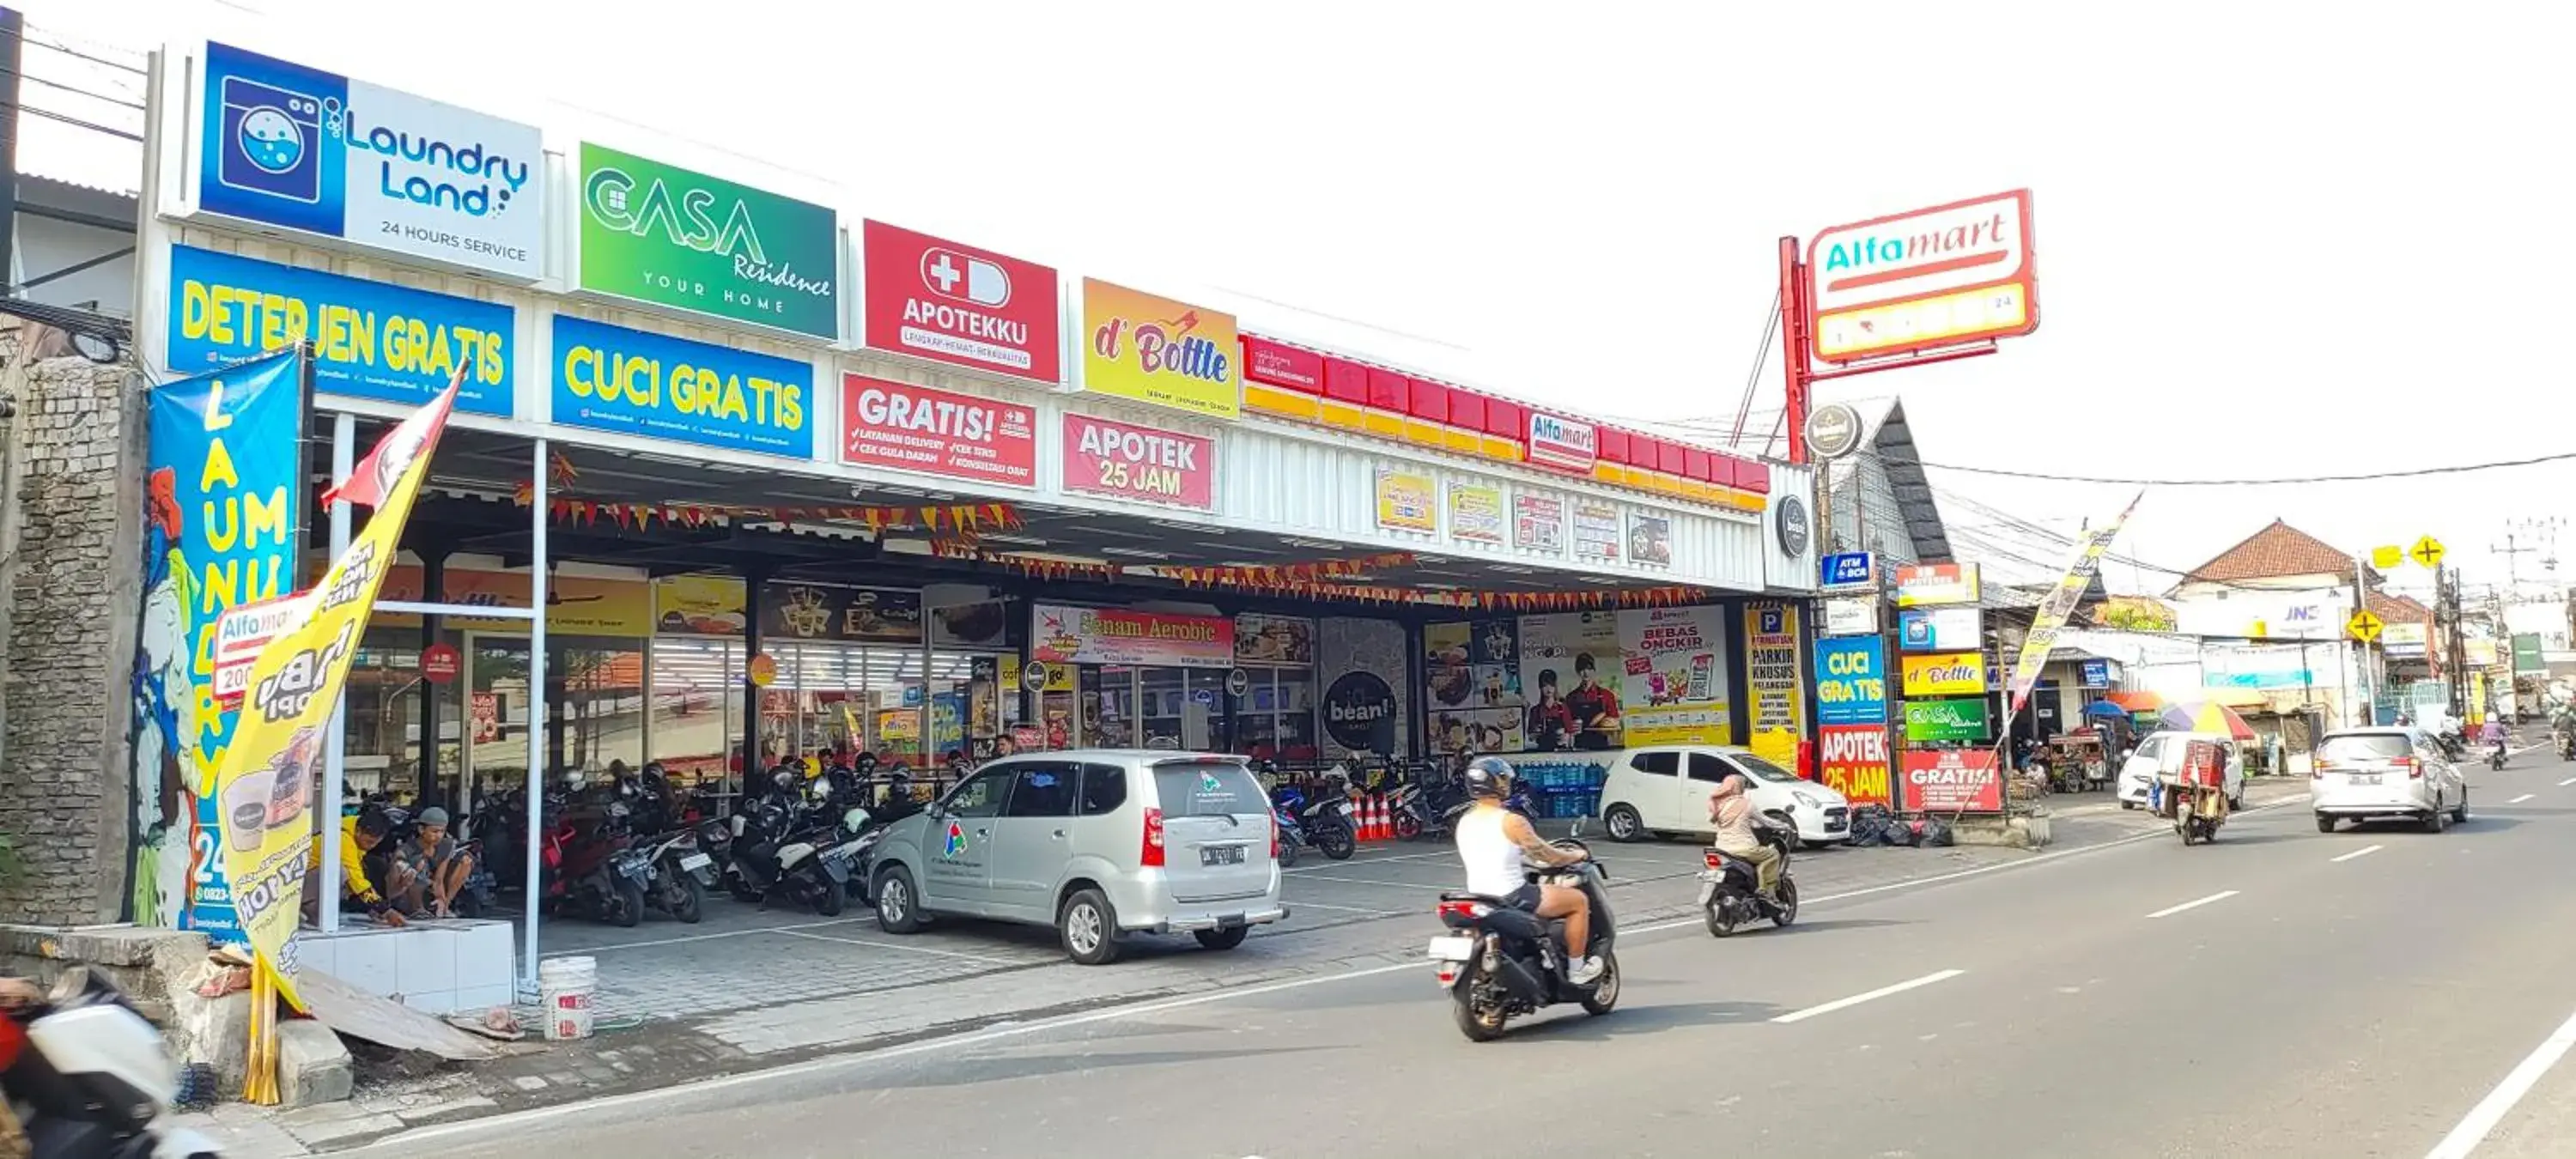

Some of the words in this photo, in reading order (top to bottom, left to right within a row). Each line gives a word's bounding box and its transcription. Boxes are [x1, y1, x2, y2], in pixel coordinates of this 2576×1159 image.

[345, 110, 528, 192] Laundry
[381, 161, 489, 216] Land
[585, 167, 766, 264] CASA
[381, 221, 400, 236] 24
[405, 226, 460, 248] HOURS
[463, 237, 527, 262] SERVICE
[1826, 213, 2008, 272] Alfamart
[734, 253, 831, 297] Residence
[644, 270, 705, 296] YOUR
[724, 289, 785, 313] HOME
[181, 279, 376, 367] DETERJEN
[383, 315, 505, 385] GRATIS
[902, 298, 1028, 345] APOTEKKU
[1134, 323, 1230, 383] Bottle
[565, 345, 659, 409] CUCI
[670, 364, 803, 431] GRATIS
[859, 389, 996, 442] GRATIS!
[1079, 424, 1196, 471] APOTEK
[1534, 416, 1592, 448] Alfamart
[1100, 460, 1129, 488] 25
[1133, 465, 1181, 495] JAM
[1840, 557, 1862, 568] ATM
[1847, 567, 1868, 578] BCA
[222, 604, 296, 640] Alfama
[1150, 617, 1216, 640] Aerobic
[1643, 626, 1698, 640] BEBAS
[1765, 614, 1777, 631] P
[1640, 636, 1704, 650] ONGKIR
[1752, 648, 1794, 664] PARKIR
[1752, 665, 1795, 680] KHUSUS
[1828, 651, 1870, 676] CUCI
[1926, 665, 1977, 683] Bottle
[1819, 678, 1883, 703] GRATIS
[1331, 698, 1388, 722] bean!
[1822, 731, 1886, 762] APOTEK
[1826, 767, 1847, 796] 25
[1849, 766, 1887, 798] JAM
[1910, 768, 1994, 785] GRATIS!
